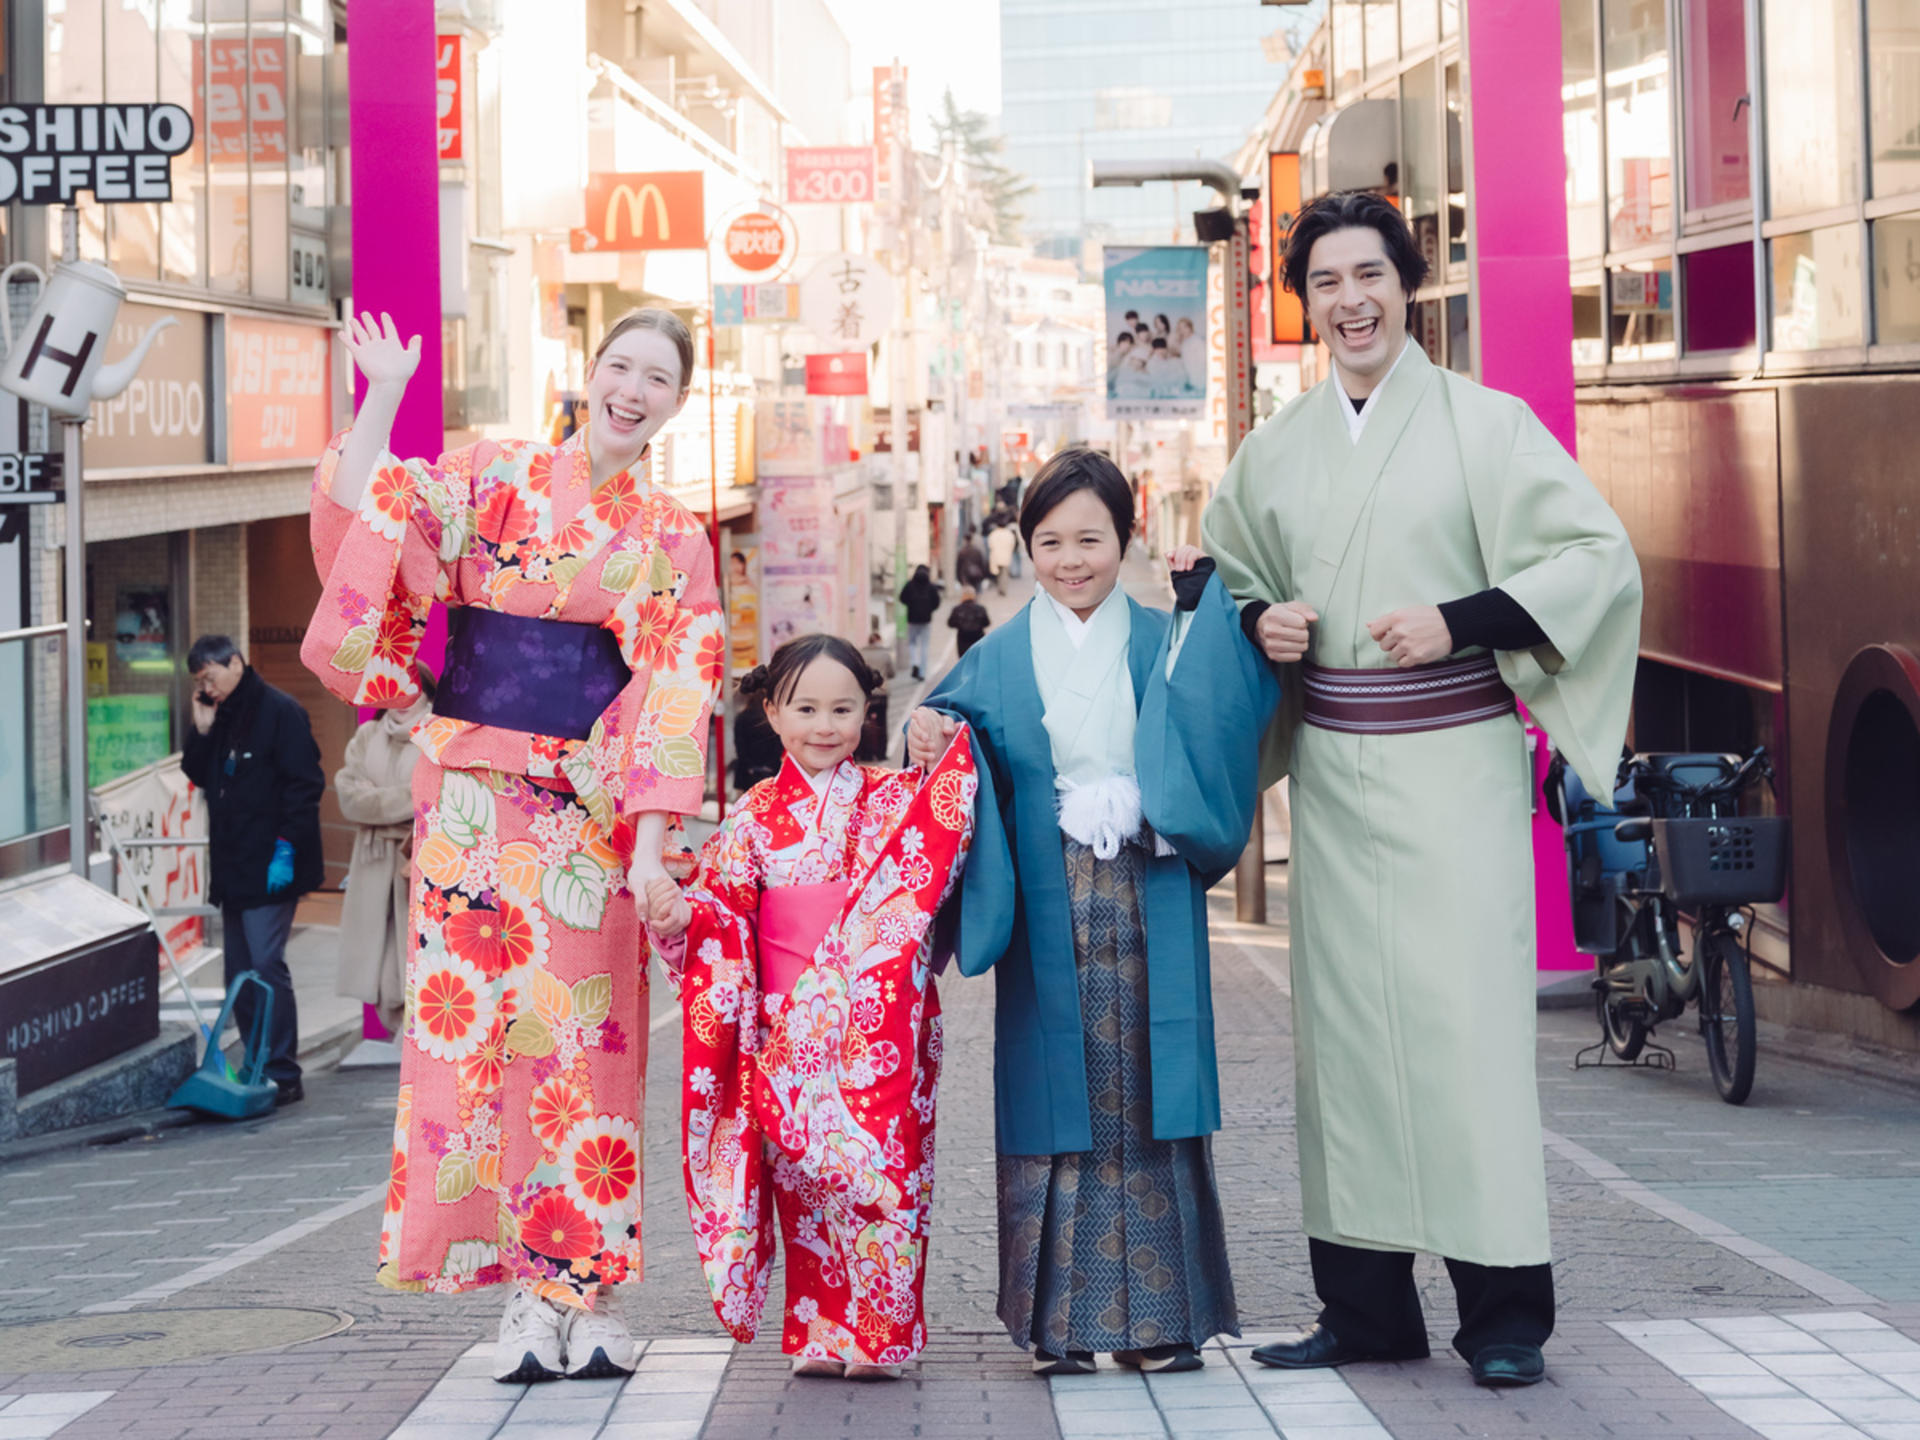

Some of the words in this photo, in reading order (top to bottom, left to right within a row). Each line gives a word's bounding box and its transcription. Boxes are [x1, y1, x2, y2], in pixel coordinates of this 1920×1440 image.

[0, 105, 191, 153] SHINO
[831, 258, 868, 340] 古着
[19, 312, 98, 398] H
[7, 1001, 83, 1052] HOSHINO
